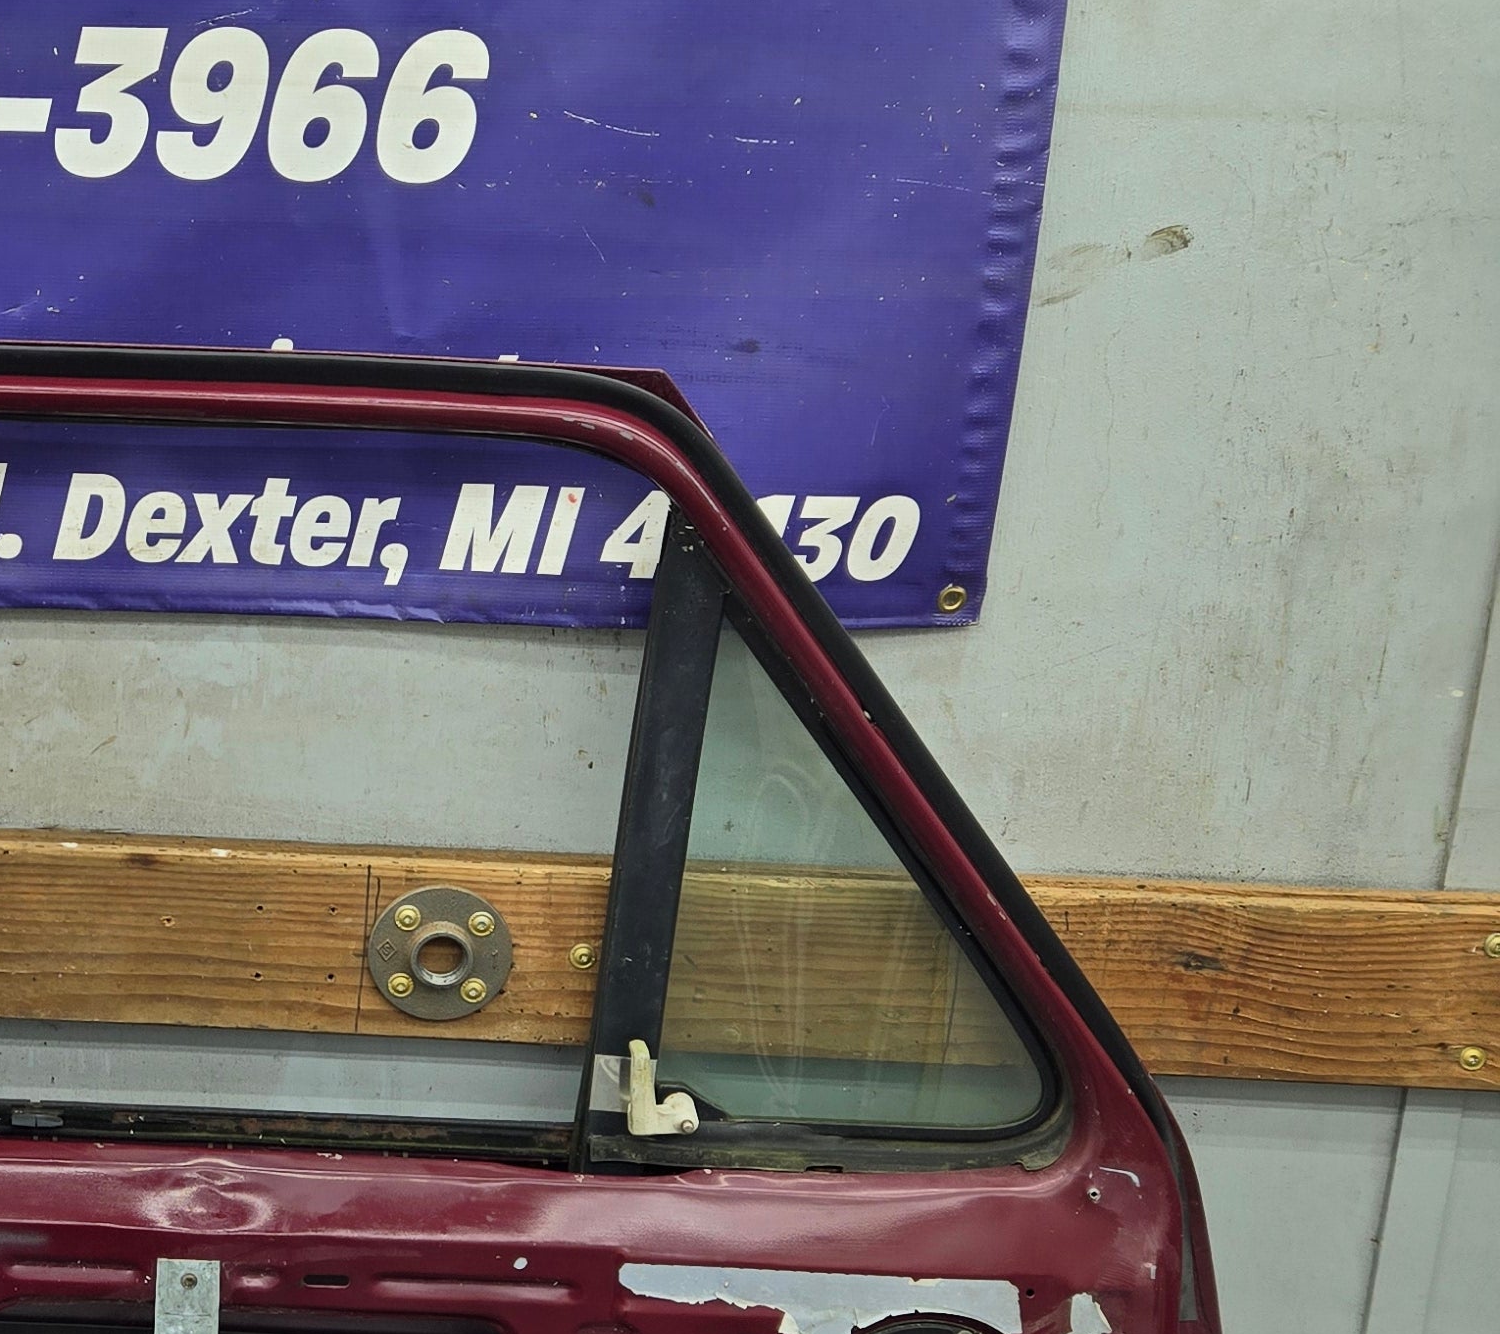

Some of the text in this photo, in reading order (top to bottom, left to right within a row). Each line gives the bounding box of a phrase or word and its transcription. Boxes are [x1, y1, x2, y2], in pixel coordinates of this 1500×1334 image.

[52, 472, 409, 586] Dexter,
[438, 483, 586, 576] MI
[599, 490, 921, 583] 430
